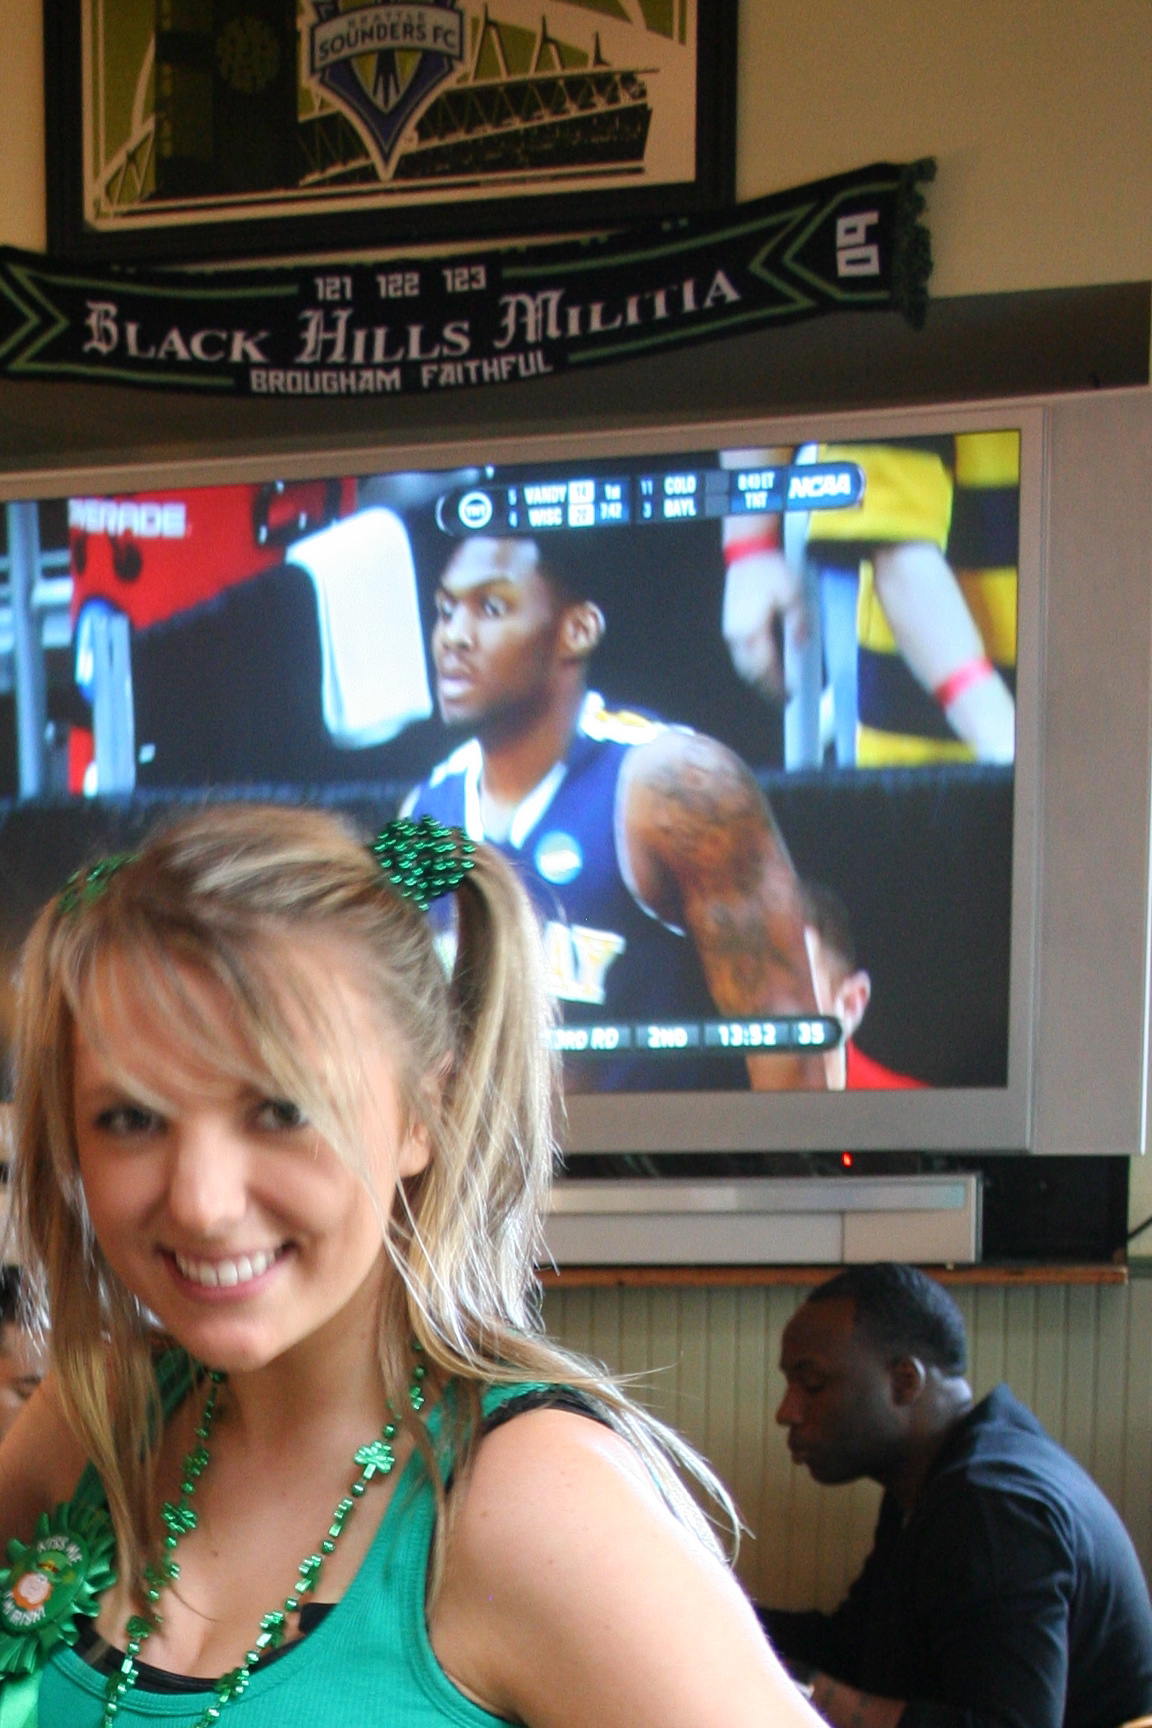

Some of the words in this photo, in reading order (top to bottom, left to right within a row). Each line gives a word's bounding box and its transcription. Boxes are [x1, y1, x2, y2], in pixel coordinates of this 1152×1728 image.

[319, 22, 427, 59] SOUNDERS
[433, 26, 457, 49] FC
[314, 276, 353, 301] 121
[376, 271, 419, 298] 122
[443, 265, 487, 293] 123
[82, 301, 273, 364] BLACK
[295, 307, 471, 365] HILLS
[250, 366, 401, 395] BROUGHAM
[421, 350, 554, 388] FAITHFUL
[523, 485, 567, 506] VANDY
[664, 474, 696, 496] COLO
[789, 474, 851, 499] NCAA
[745, 491, 768, 510] TNT
[528, 507, 563, 528] WISC
[590, 1026, 620, 1050] RD
[648, 1025, 689, 1049] 2ND
[718, 1023, 777, 1048] 13:52
[798, 1021, 826, 1046] 35
